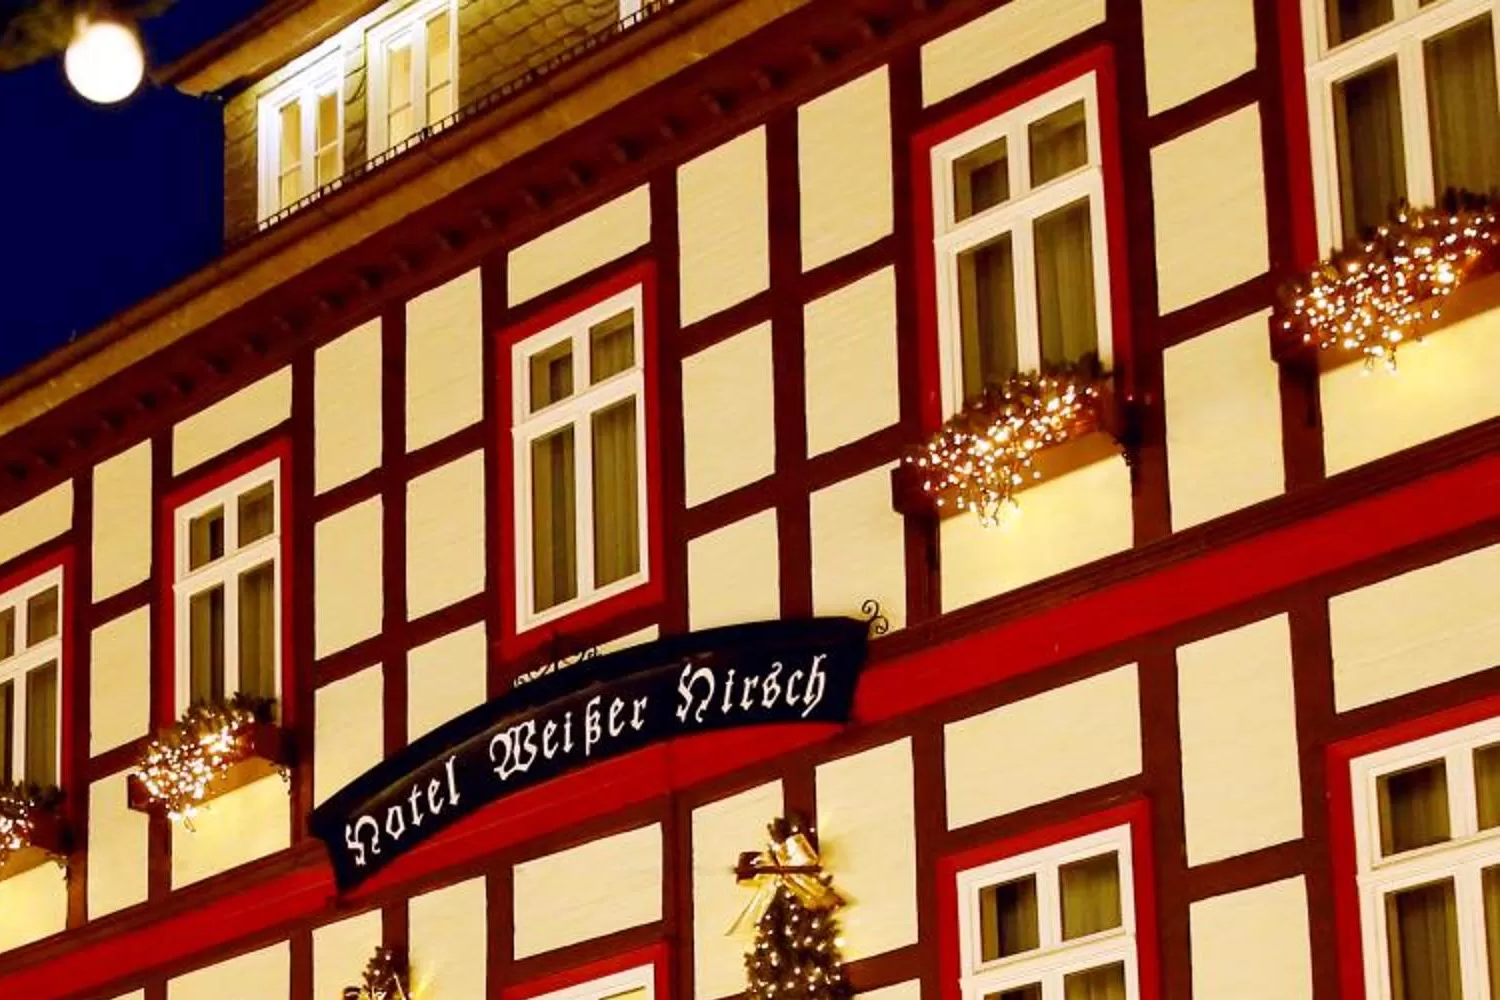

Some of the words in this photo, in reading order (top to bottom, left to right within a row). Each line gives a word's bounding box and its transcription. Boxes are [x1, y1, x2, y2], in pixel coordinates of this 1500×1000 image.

[345, 756, 461, 866] Hotel
[489, 695, 648, 781] Weißer
[675, 653, 828, 723] Hirsch
